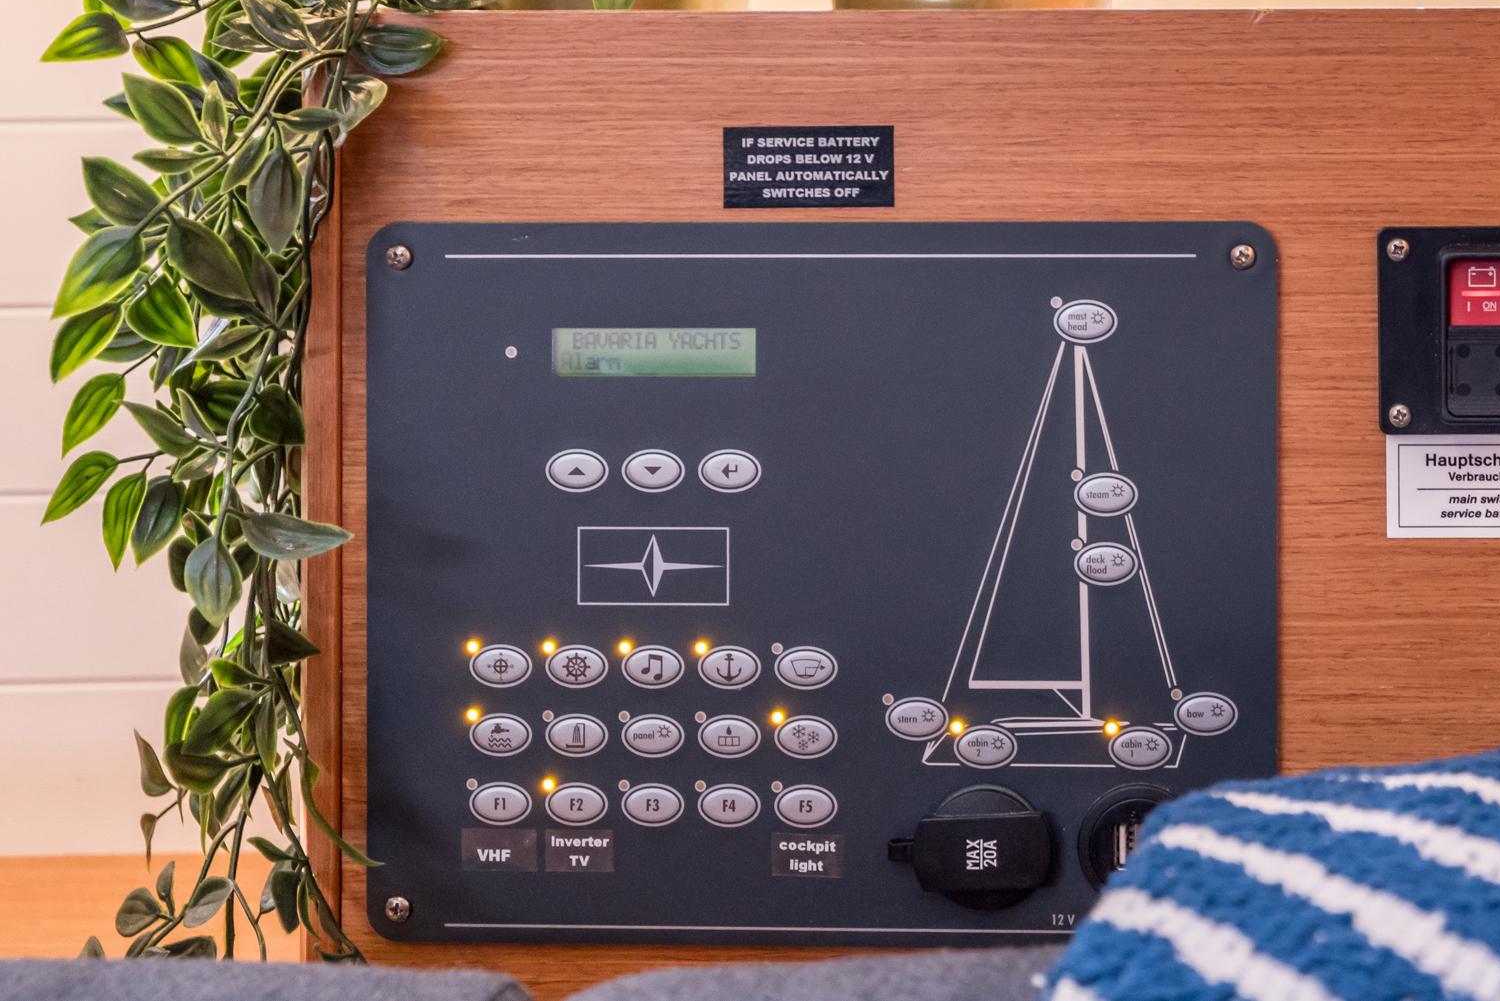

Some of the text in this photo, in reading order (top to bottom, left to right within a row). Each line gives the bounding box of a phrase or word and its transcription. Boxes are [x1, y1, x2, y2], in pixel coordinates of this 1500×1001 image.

[742, 137, 880, 148] IF SERVICE BATTERY
[747, 154, 875, 164] DROPS BELOW 12 V
[729, 170, 889, 181] PANEL AUTOMATICALLY
[762, 187, 860, 198] SWITCHES OFF
[1482, 301, 1497, 312] ON
[1068, 312, 1087, 321] mast
[1067, 322, 1087, 331] head
[572, 332, 742, 350] BAVARIA YACHTS
[560, 353, 621, 370] Alarm
[1086, 490, 1109, 499] steam
[1448, 494, 1477, 504] main
[1440, 509, 1482, 519] service
[1086, 555, 1105, 564] deck
[1086, 565, 1107, 575] flood
[1186, 708, 1204, 718] bow
[897, 715, 918, 724] stern
[632, 730, 655, 742] panel
[967, 738, 989, 748] cabin
[1121, 739, 1142, 749] cabin
[976, 748, 982, 758] 2
[494, 797, 507, 811] F1
[570, 798, 583, 811] F2
[646, 799, 659, 812] F3
[722, 799, 736, 812] F4
[799, 800, 812, 813] F5
[779, 840, 836, 854] cockpit
[477, 848, 511, 862] VHF
[966, 839, 980, 870] MAX
[983, 839, 997, 868] 20A
[569, 855, 590, 867] TV
[789, 859, 824, 873] light
[1051, 914, 1076, 926] 12 V
